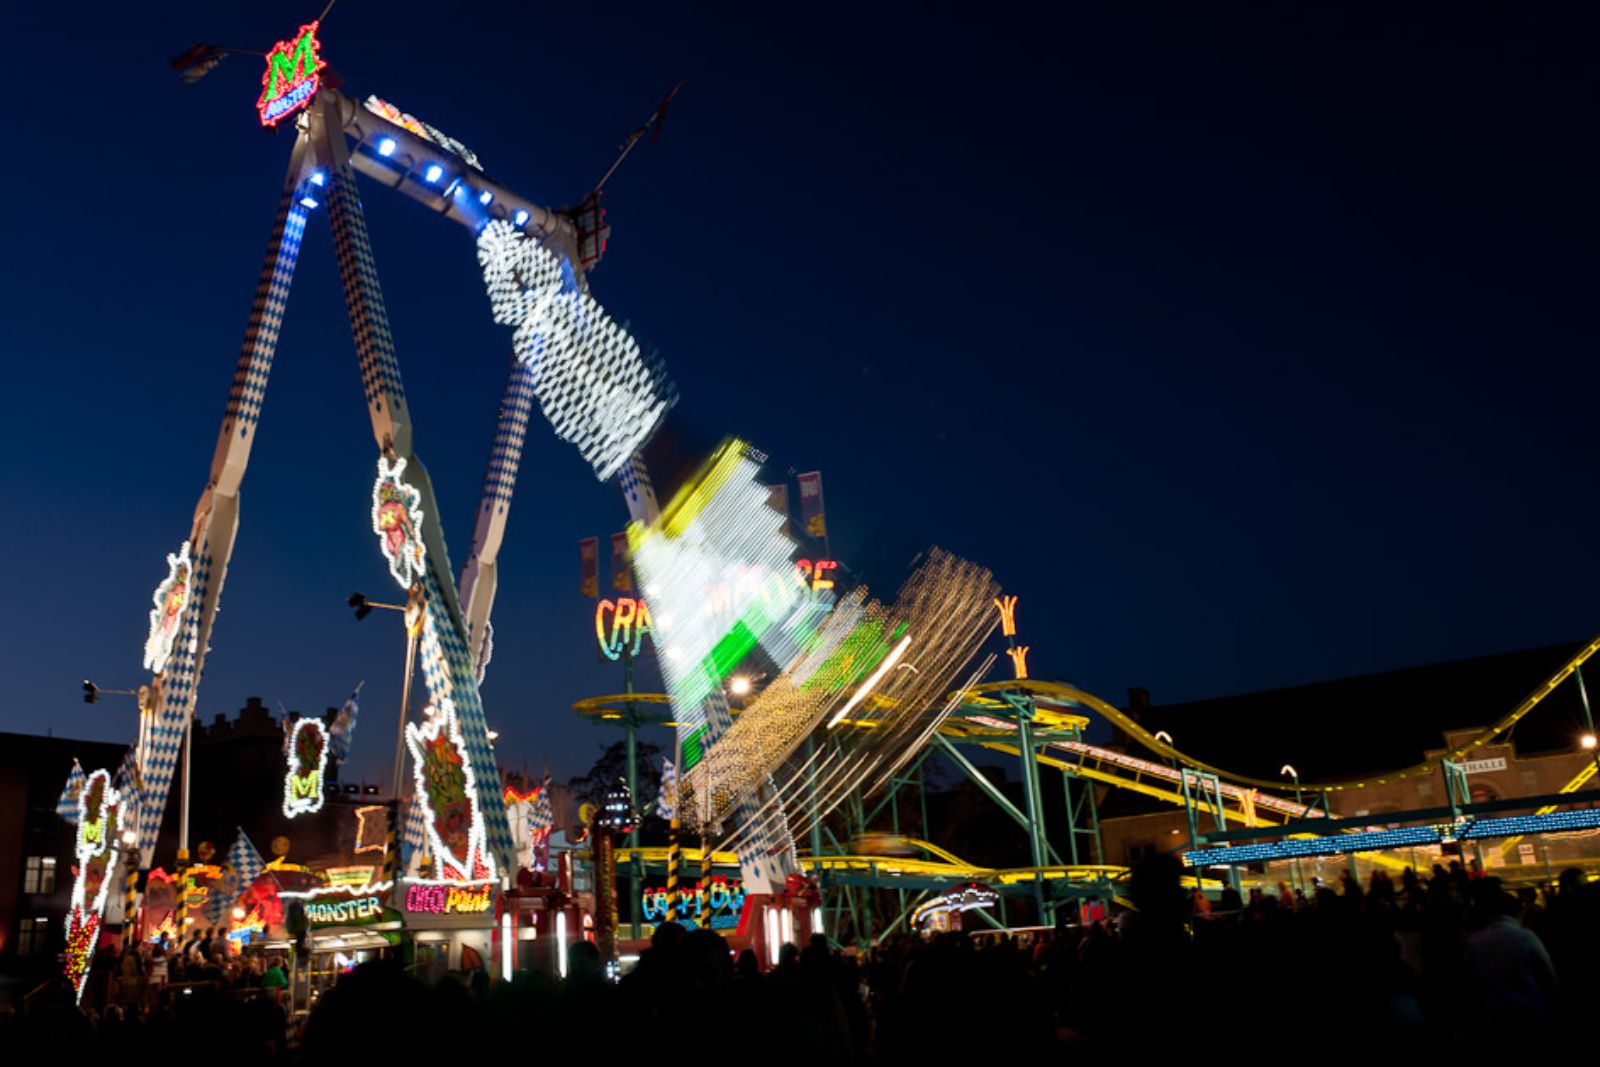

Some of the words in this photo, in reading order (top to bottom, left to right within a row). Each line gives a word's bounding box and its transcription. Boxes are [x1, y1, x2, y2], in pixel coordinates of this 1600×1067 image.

[263, 31, 318, 102] M
[595, 597, 654, 660] CRA
[290, 769, 319, 801] M
[306, 897, 382, 922] MONSTER
[445, 883, 491, 913] Point
